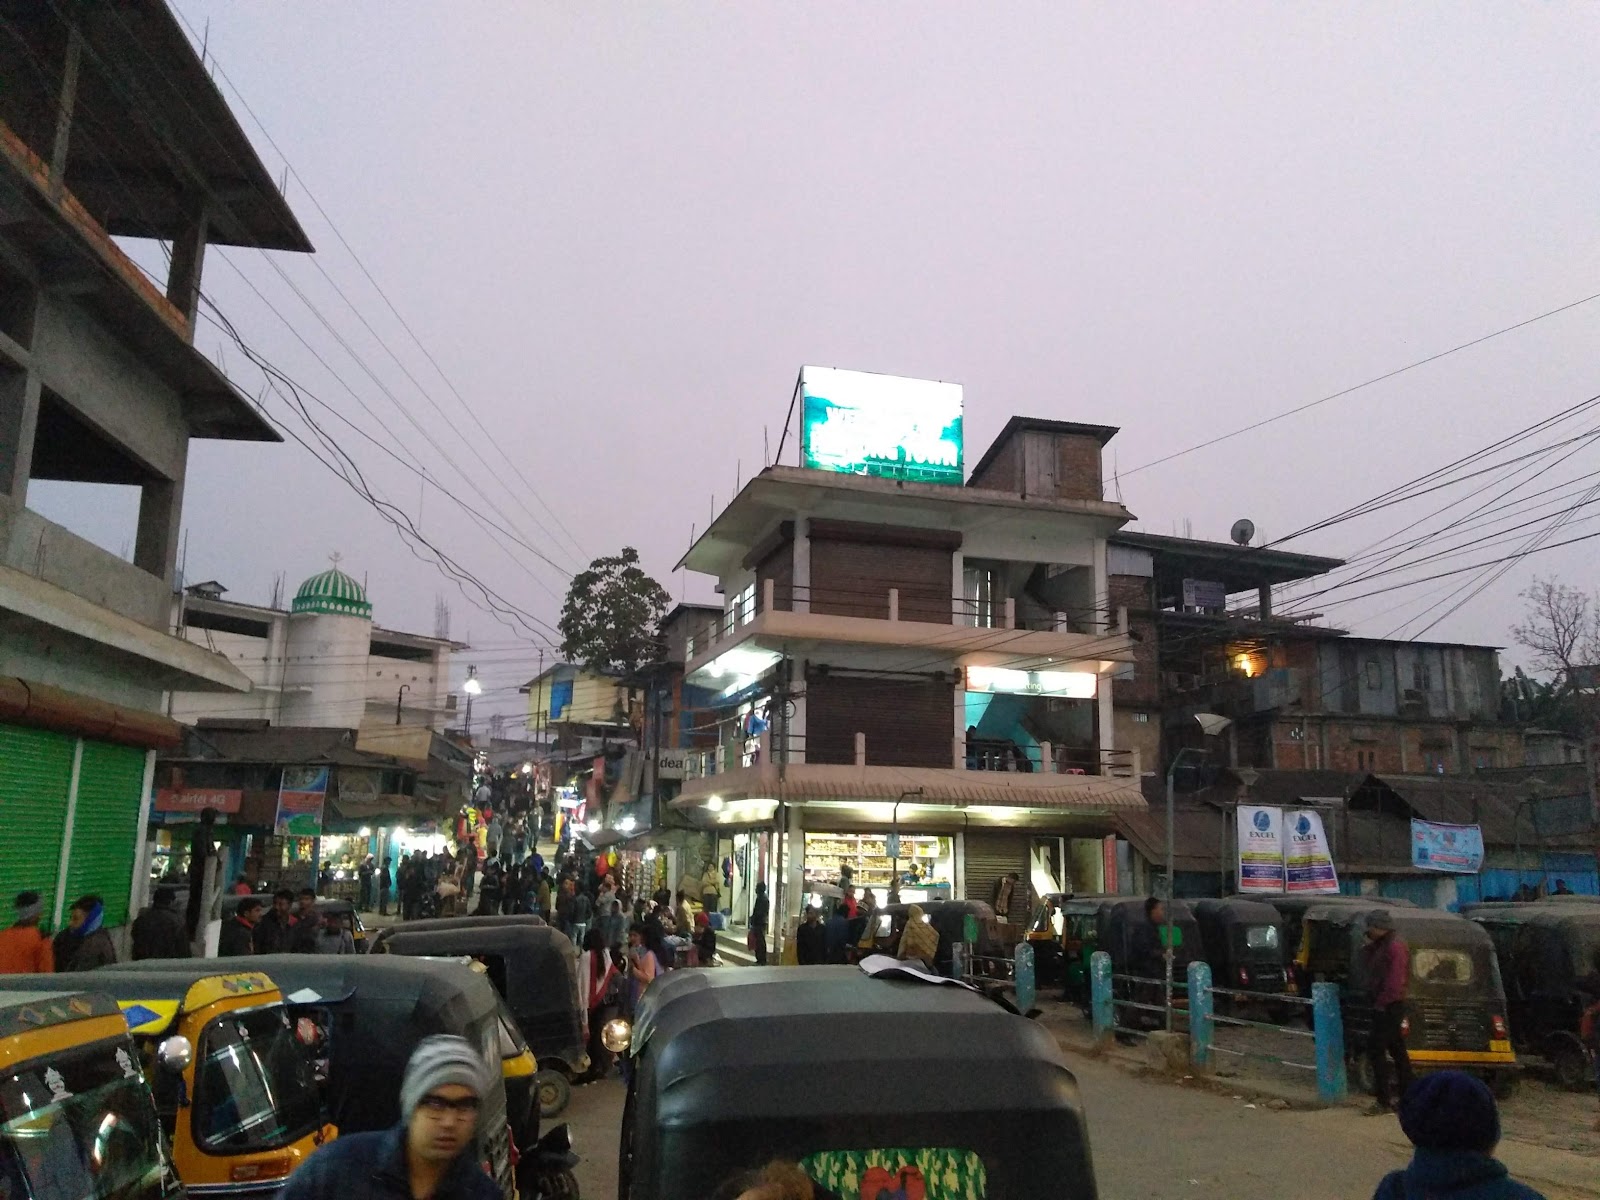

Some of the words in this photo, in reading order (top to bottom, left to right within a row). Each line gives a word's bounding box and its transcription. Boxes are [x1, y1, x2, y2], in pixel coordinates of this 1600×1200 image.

[659, 757, 684, 769] dea
[180, 792, 207, 804] airtel
[209, 793, 226, 805] 4G
